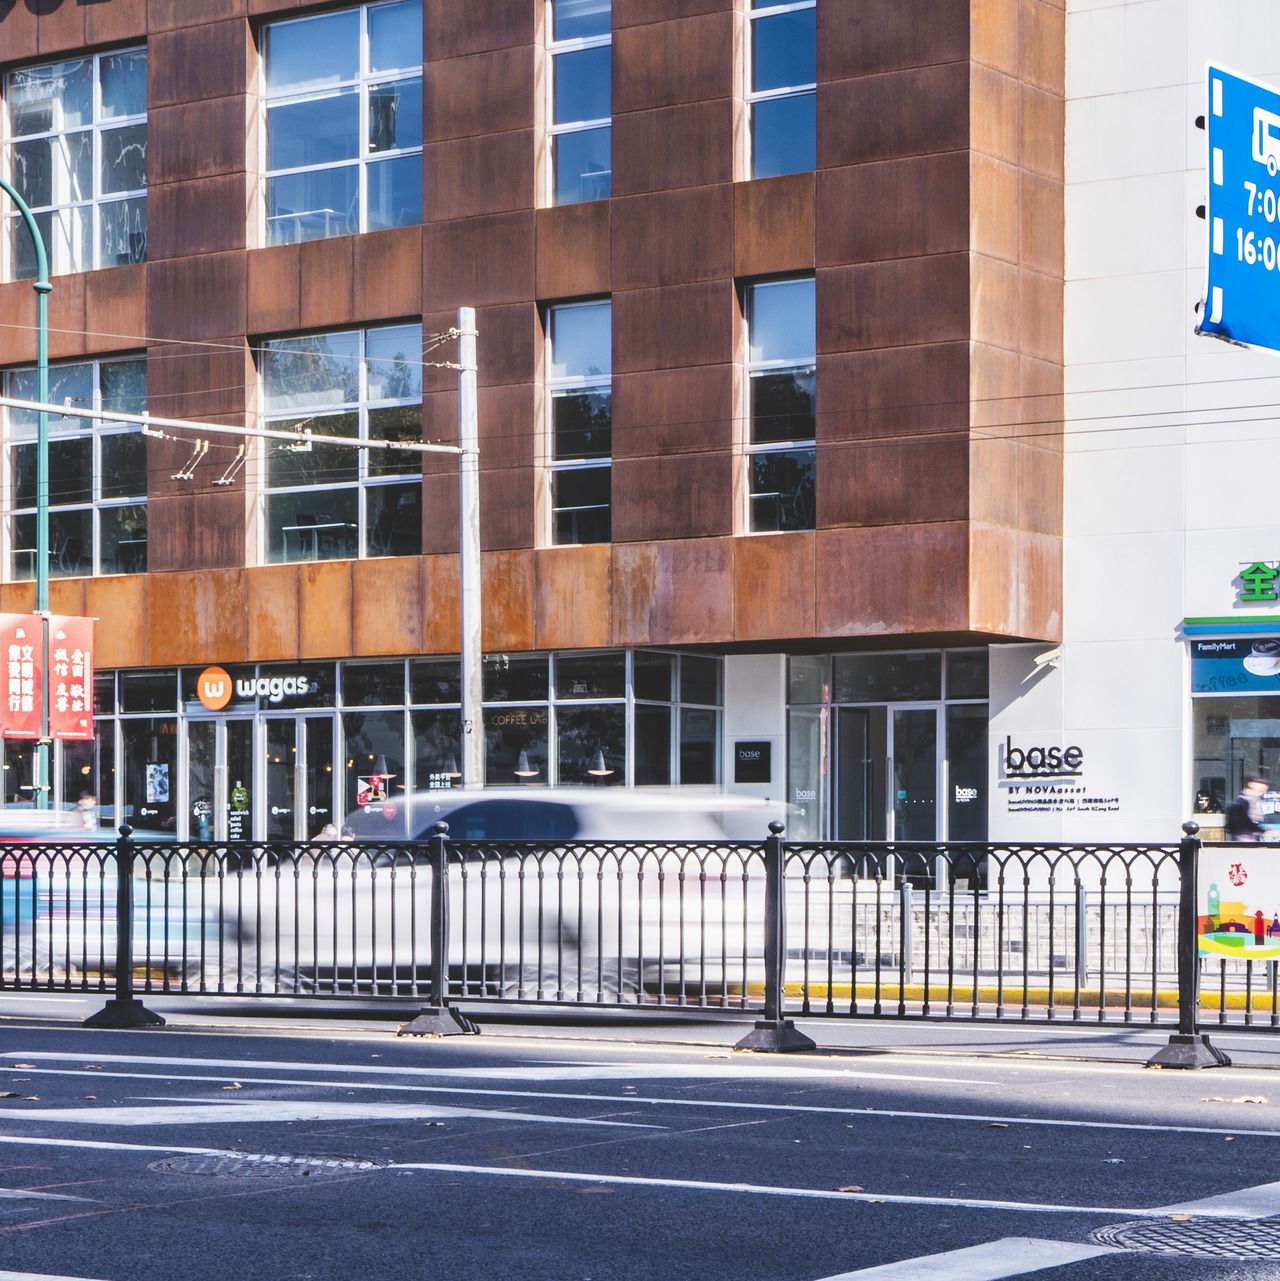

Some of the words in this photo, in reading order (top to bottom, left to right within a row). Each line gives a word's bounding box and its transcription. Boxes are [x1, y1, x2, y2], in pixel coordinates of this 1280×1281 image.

[1198, 642, 1236, 651] FamilyMart
[236, 676, 309, 702] wagas
[739, 750, 760, 758] base
[1007, 735, 1084, 770] base
[795, 787, 816, 797] base
[955, 785, 978, 796] base
